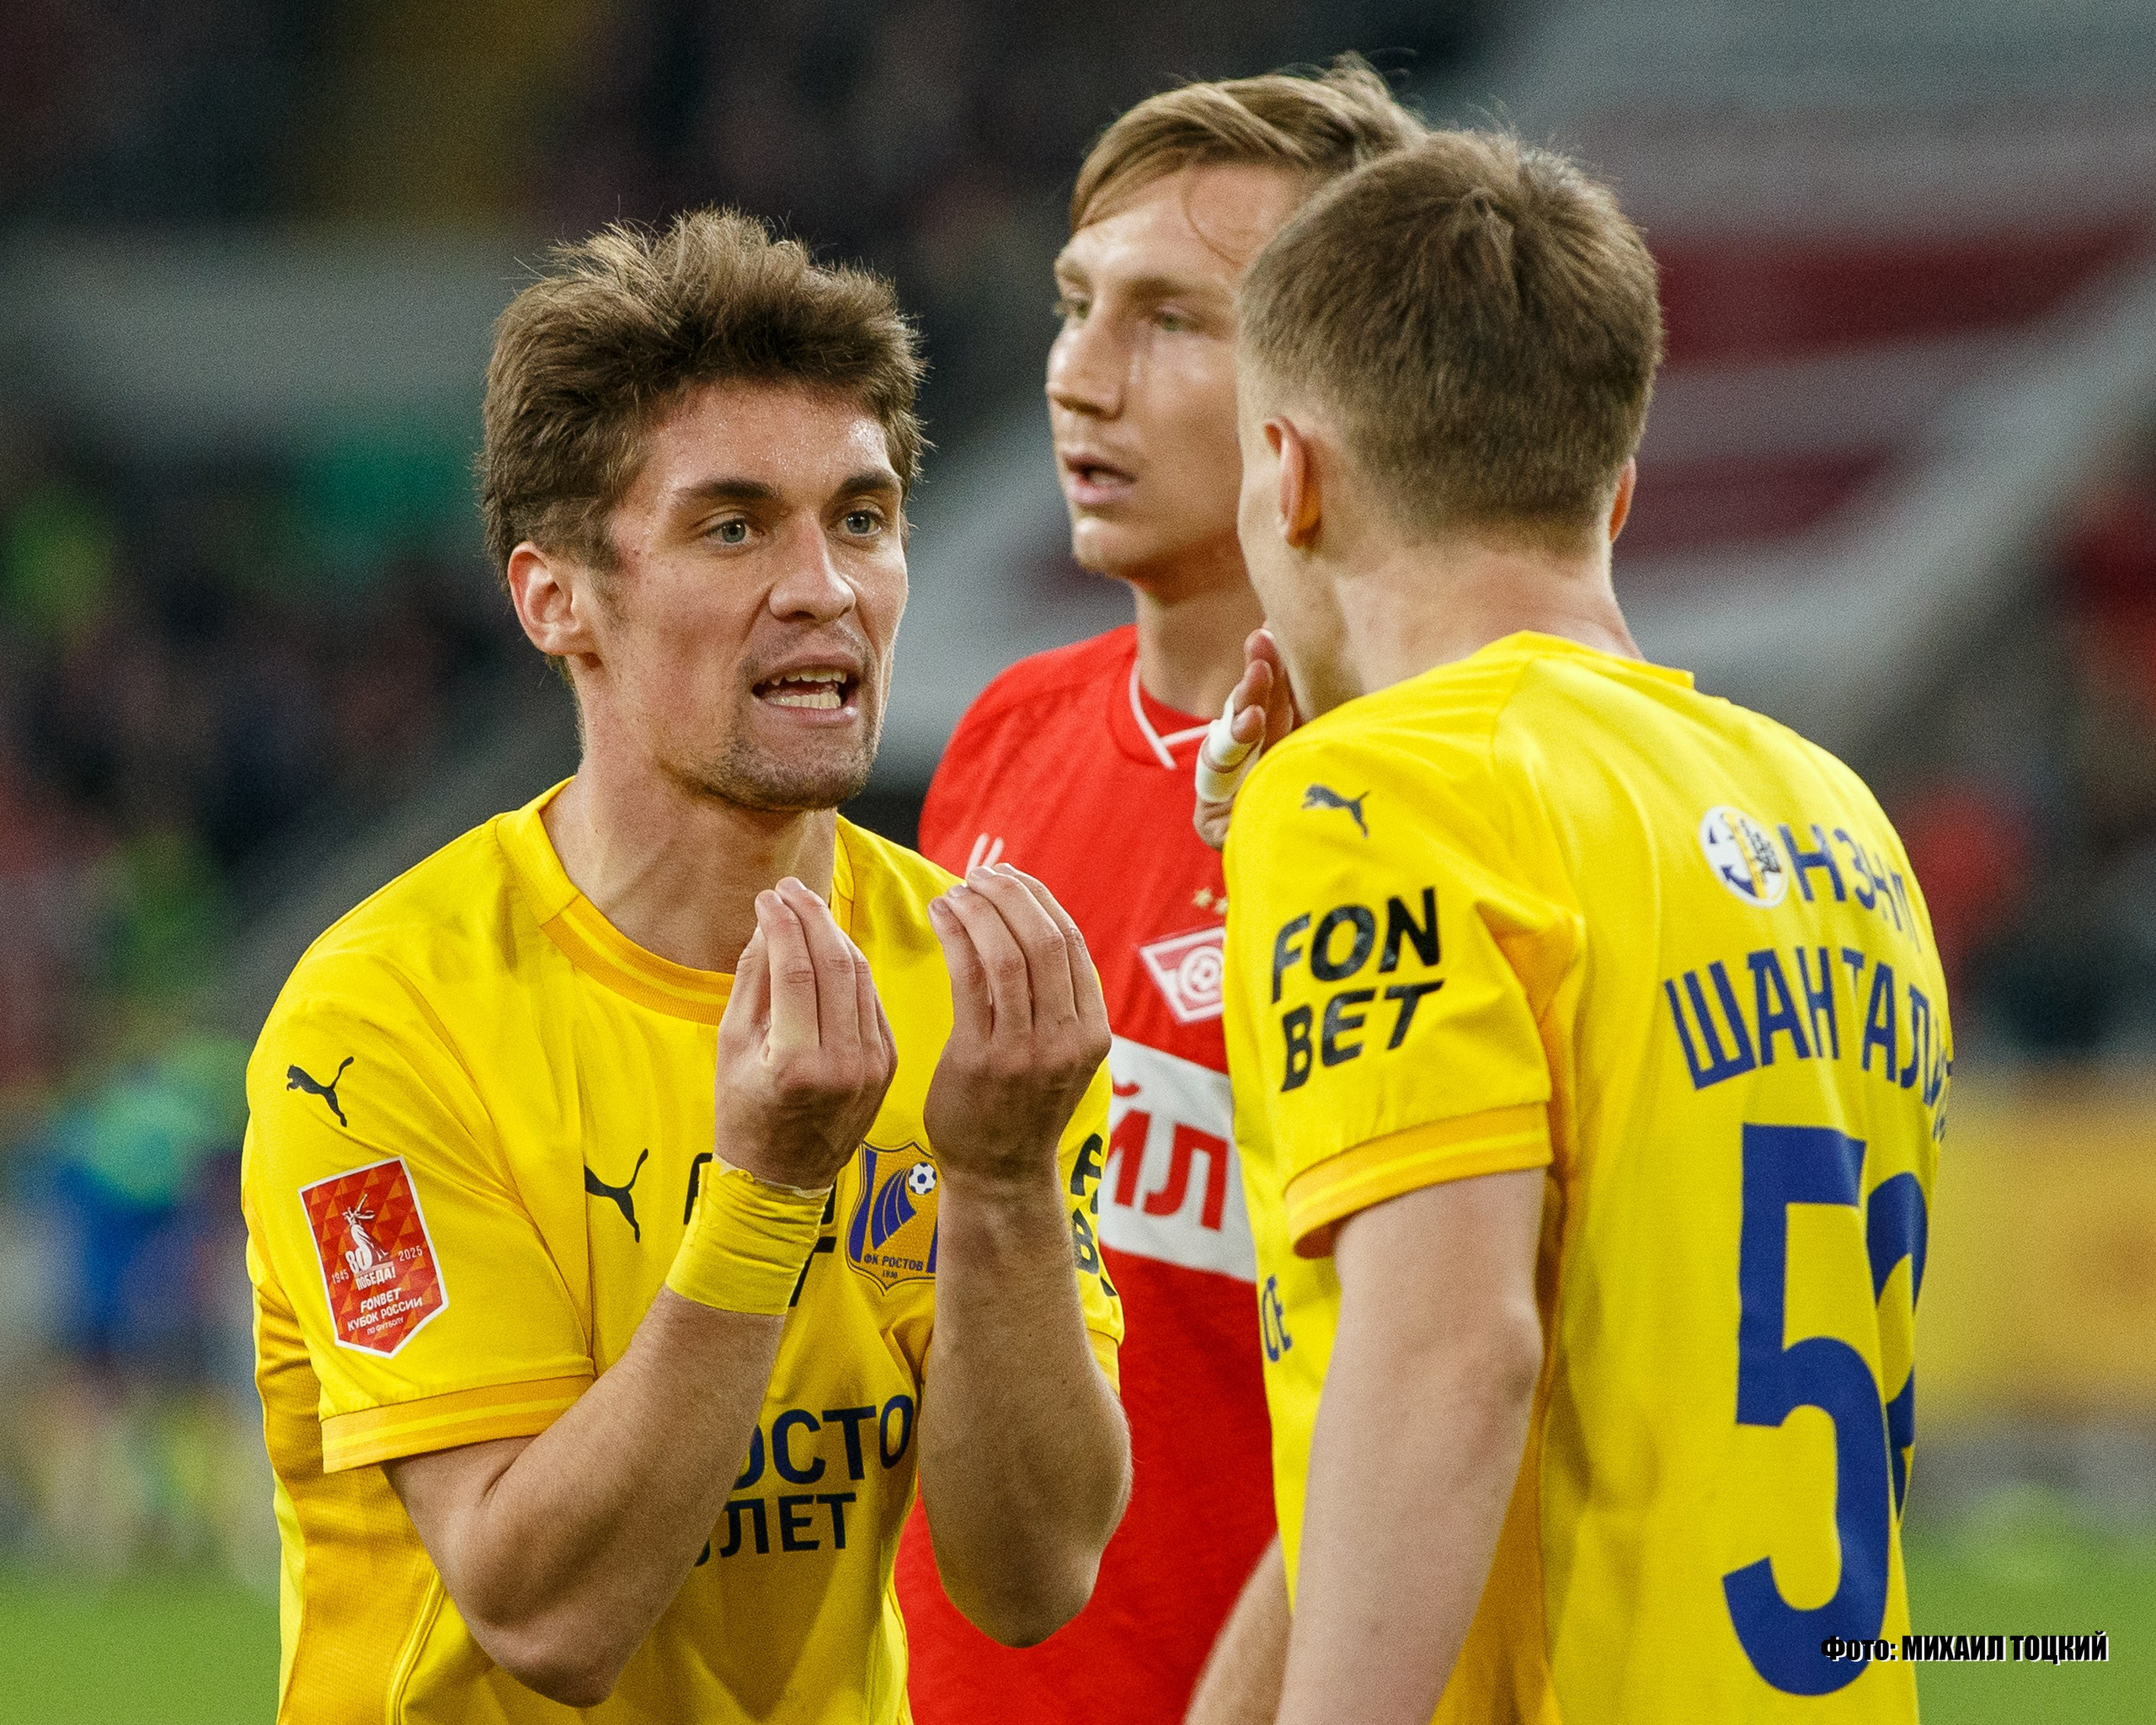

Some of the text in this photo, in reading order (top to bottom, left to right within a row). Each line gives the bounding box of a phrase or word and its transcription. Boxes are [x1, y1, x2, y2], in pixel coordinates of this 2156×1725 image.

[1272, 885, 1440, 1005] FON
[1280, 978, 1445, 1092] BET
[345, 1250, 373, 1274] 80
[398, 1246, 423, 1262] 2025
[863, 1252, 924, 1272] ФК РОСТОВ
[331, 1268, 350, 1285] 1945
[355, 1266, 396, 1290] ПОБЕДА!
[360, 1287, 402, 1313] FONBET
[347, 1298, 423, 1332] КУБОК РОССИИ
[694, 1492, 856, 1567] ЛЕТ
